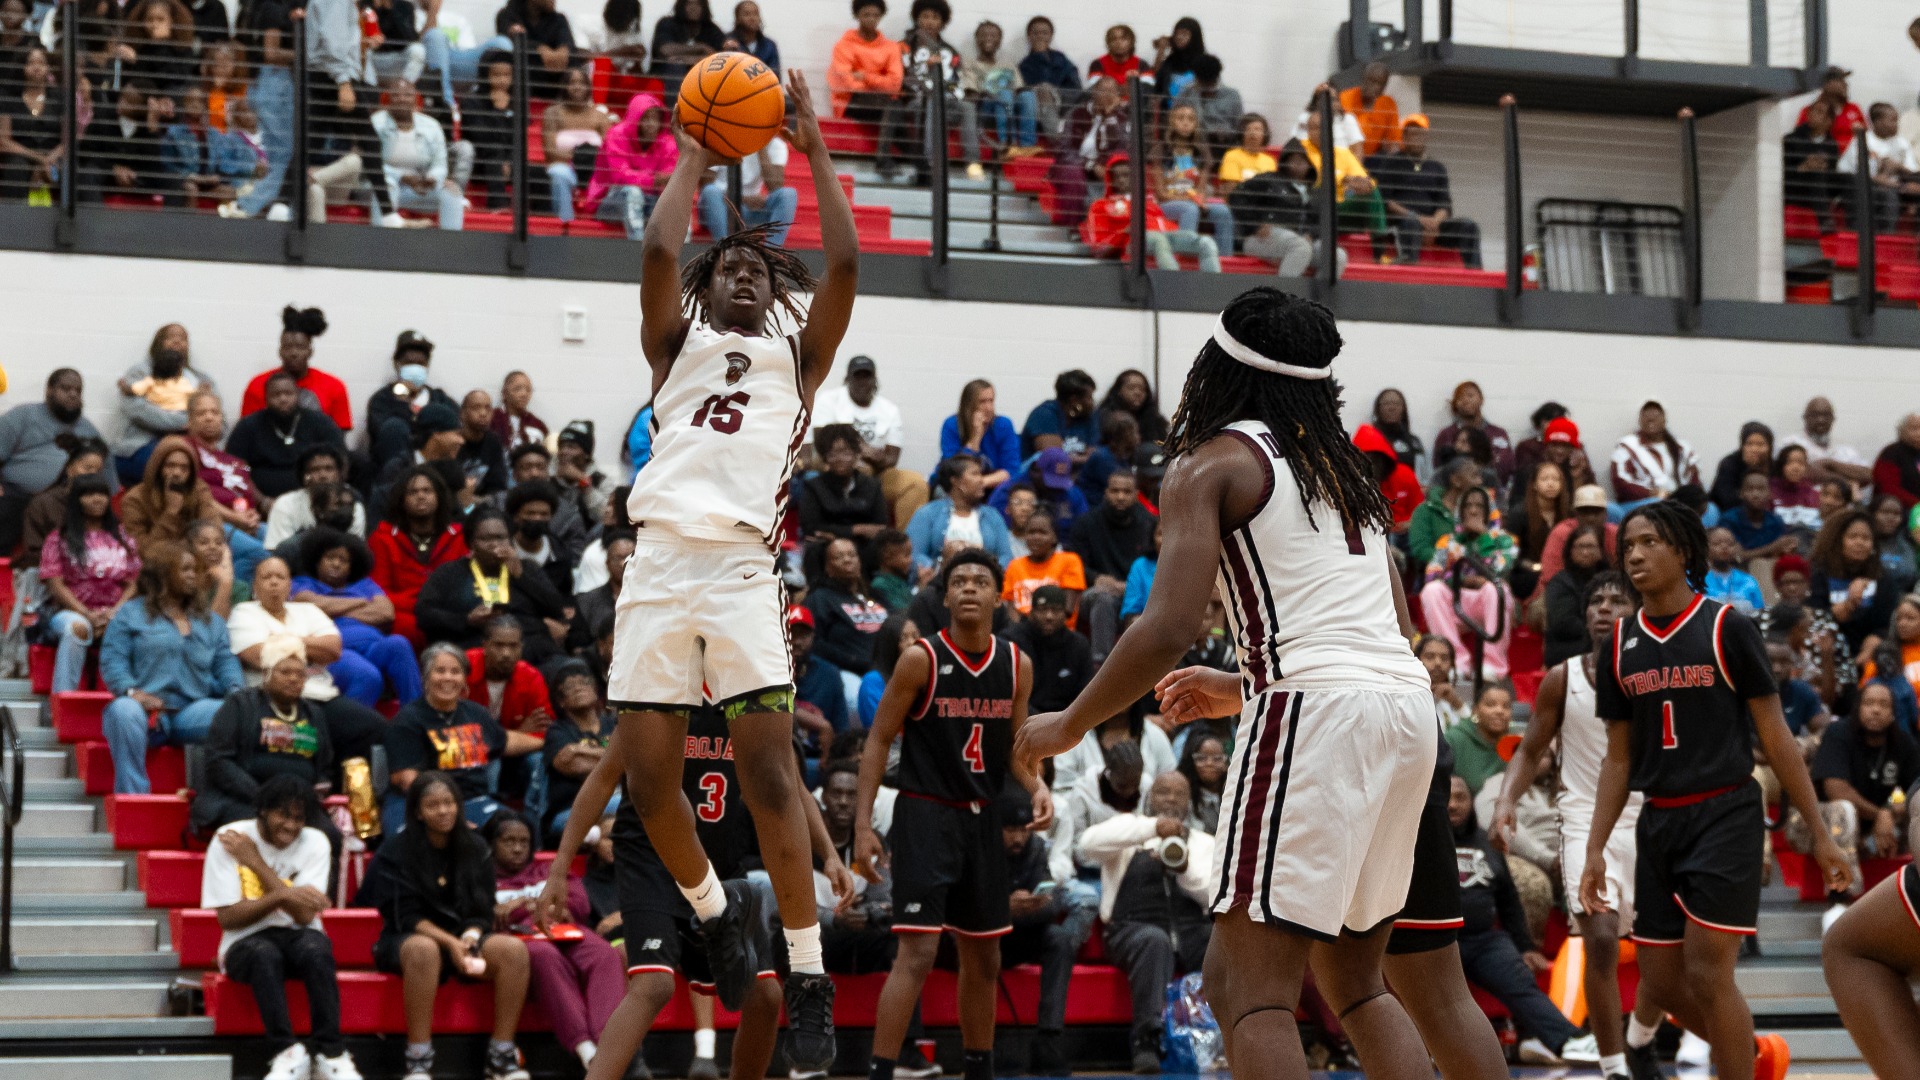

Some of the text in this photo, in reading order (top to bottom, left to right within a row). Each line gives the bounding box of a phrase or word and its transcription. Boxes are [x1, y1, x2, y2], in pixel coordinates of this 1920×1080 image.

[690, 391, 752, 435] 15
[1622, 665, 1715, 696] TROJANS
[935, 698, 1013, 718] TROJANS
[1663, 700, 1678, 749] 1
[684, 735, 734, 760] ROJA
[962, 723, 985, 773] 4
[697, 772, 727, 823] 3
